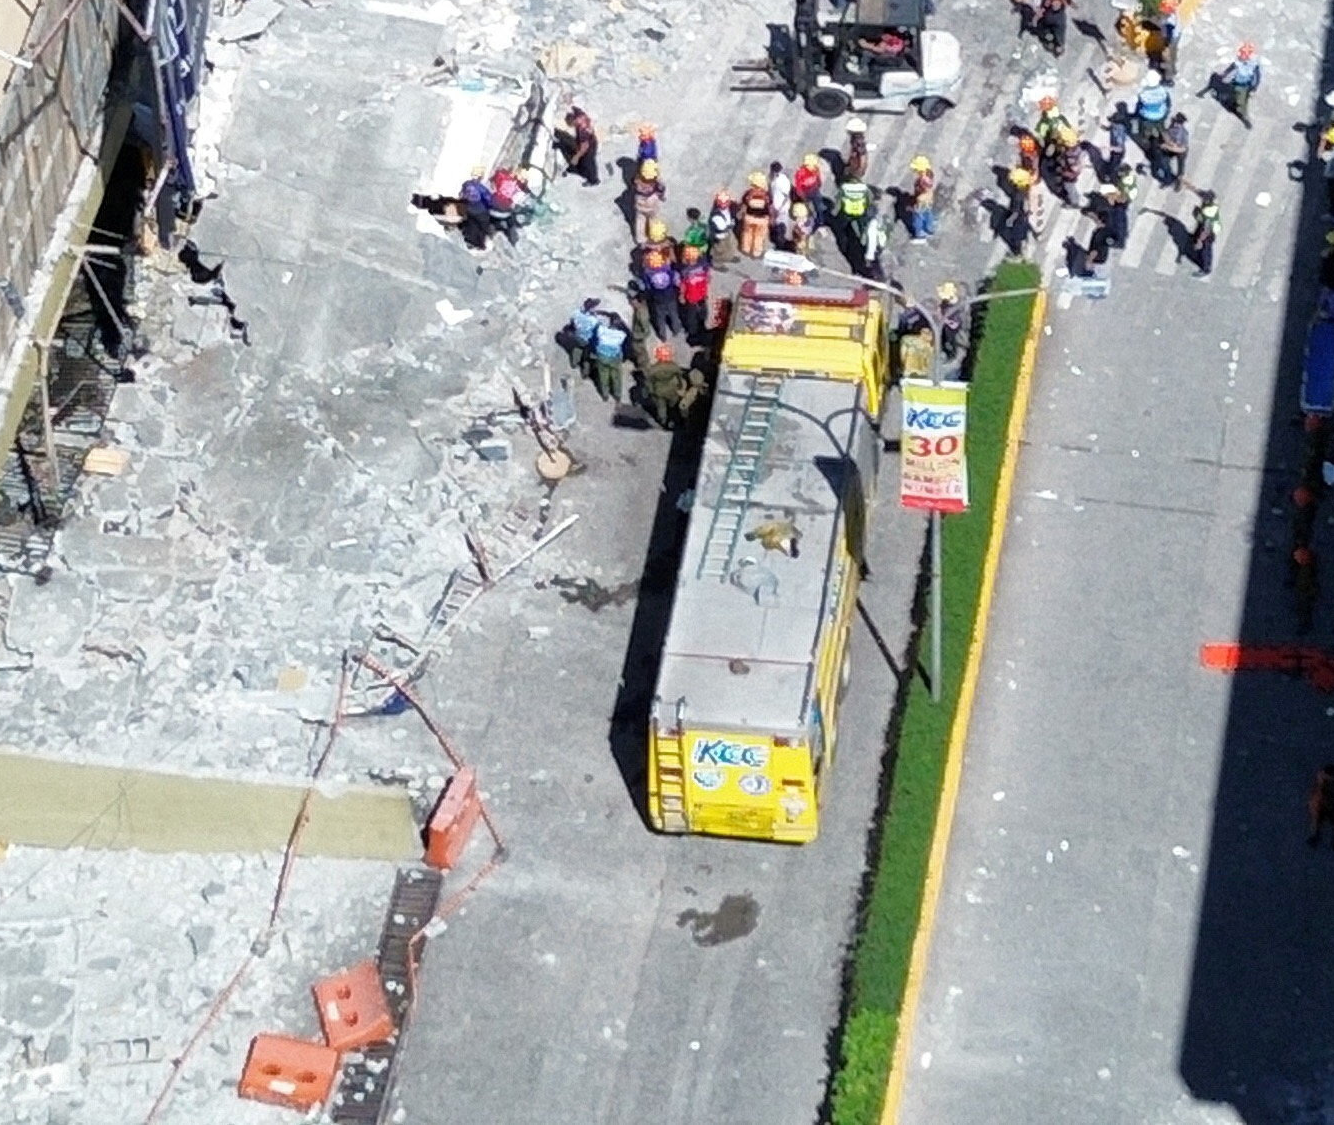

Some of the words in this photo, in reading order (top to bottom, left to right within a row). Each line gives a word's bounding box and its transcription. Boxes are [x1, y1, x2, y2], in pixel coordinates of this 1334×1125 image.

[907, 407, 963, 429] KCC
[907, 435, 959, 457] 30
[694, 739, 767, 768] KCC
